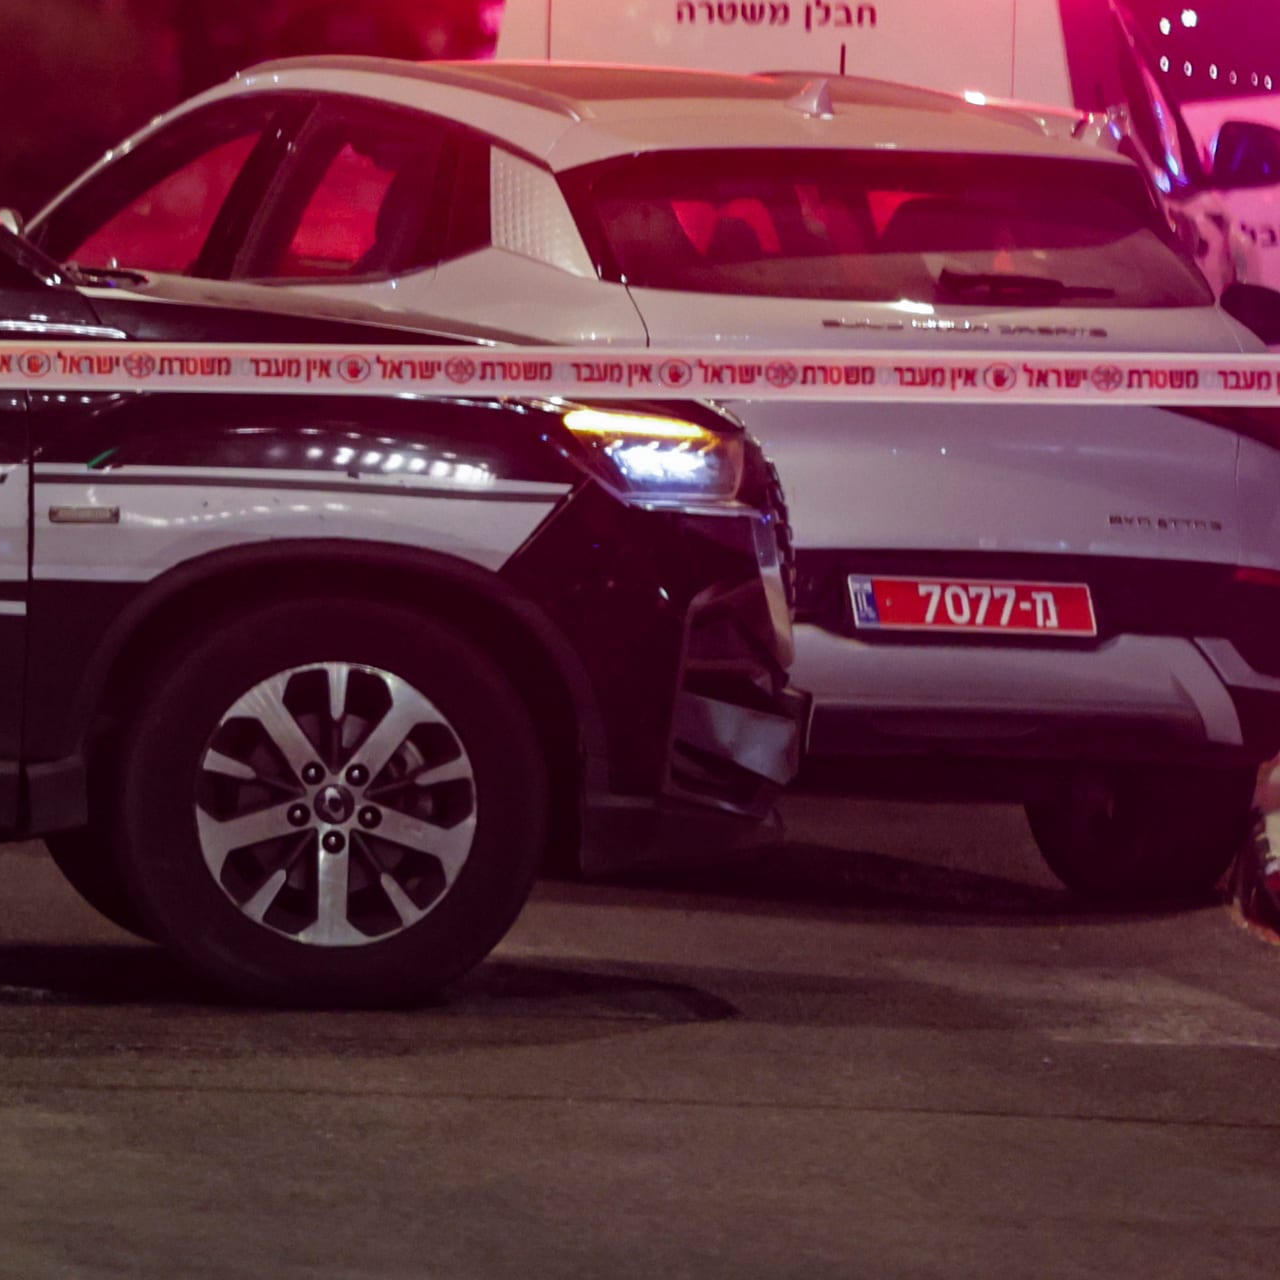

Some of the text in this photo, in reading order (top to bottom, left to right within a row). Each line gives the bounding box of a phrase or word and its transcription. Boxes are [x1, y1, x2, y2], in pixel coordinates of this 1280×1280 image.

[676, 0, 790, 26] משטרה
[56, 351, 120, 375] ישראל
[249, 357, 301, 378] מעבר
[306, 359, 332, 382] אין
[376, 356, 442, 380] ישראל
[571, 363, 623, 382] מעבר
[697, 359, 762, 384] ישראל
[627, 364, 652, 387] אין
[894, 367, 947, 387] מעבר
[951, 368, 977, 391] אין
[1022, 364, 1088, 388] ישראל
[1217, 370, 1272, 390] מעבר
